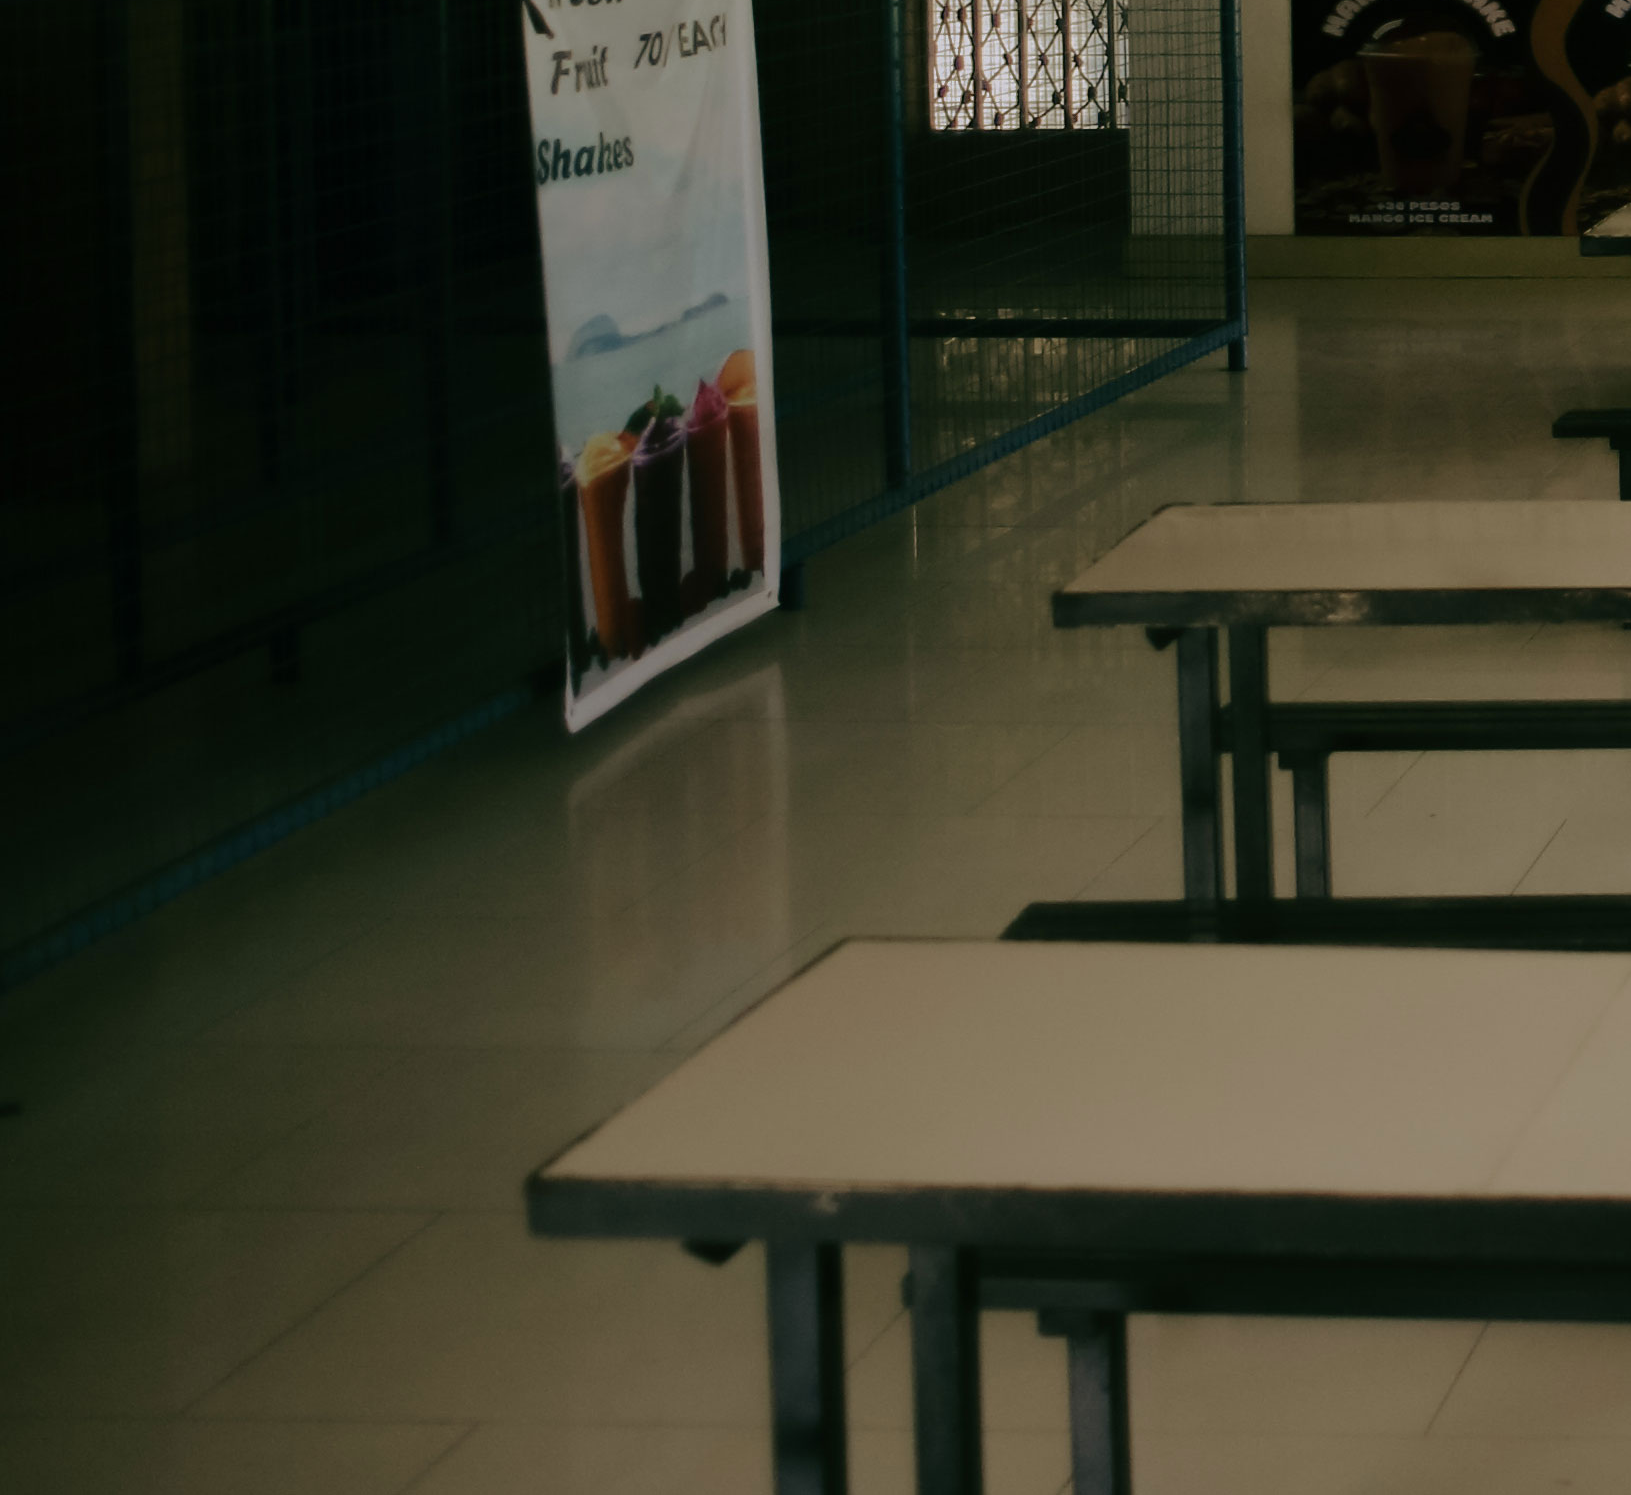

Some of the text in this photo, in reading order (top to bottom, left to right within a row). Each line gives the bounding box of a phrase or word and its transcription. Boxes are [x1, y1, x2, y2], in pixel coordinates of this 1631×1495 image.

[1409, 201, 1461, 212] PESOS
[1348, 213, 1494, 224] MANGO ICE CREAM
